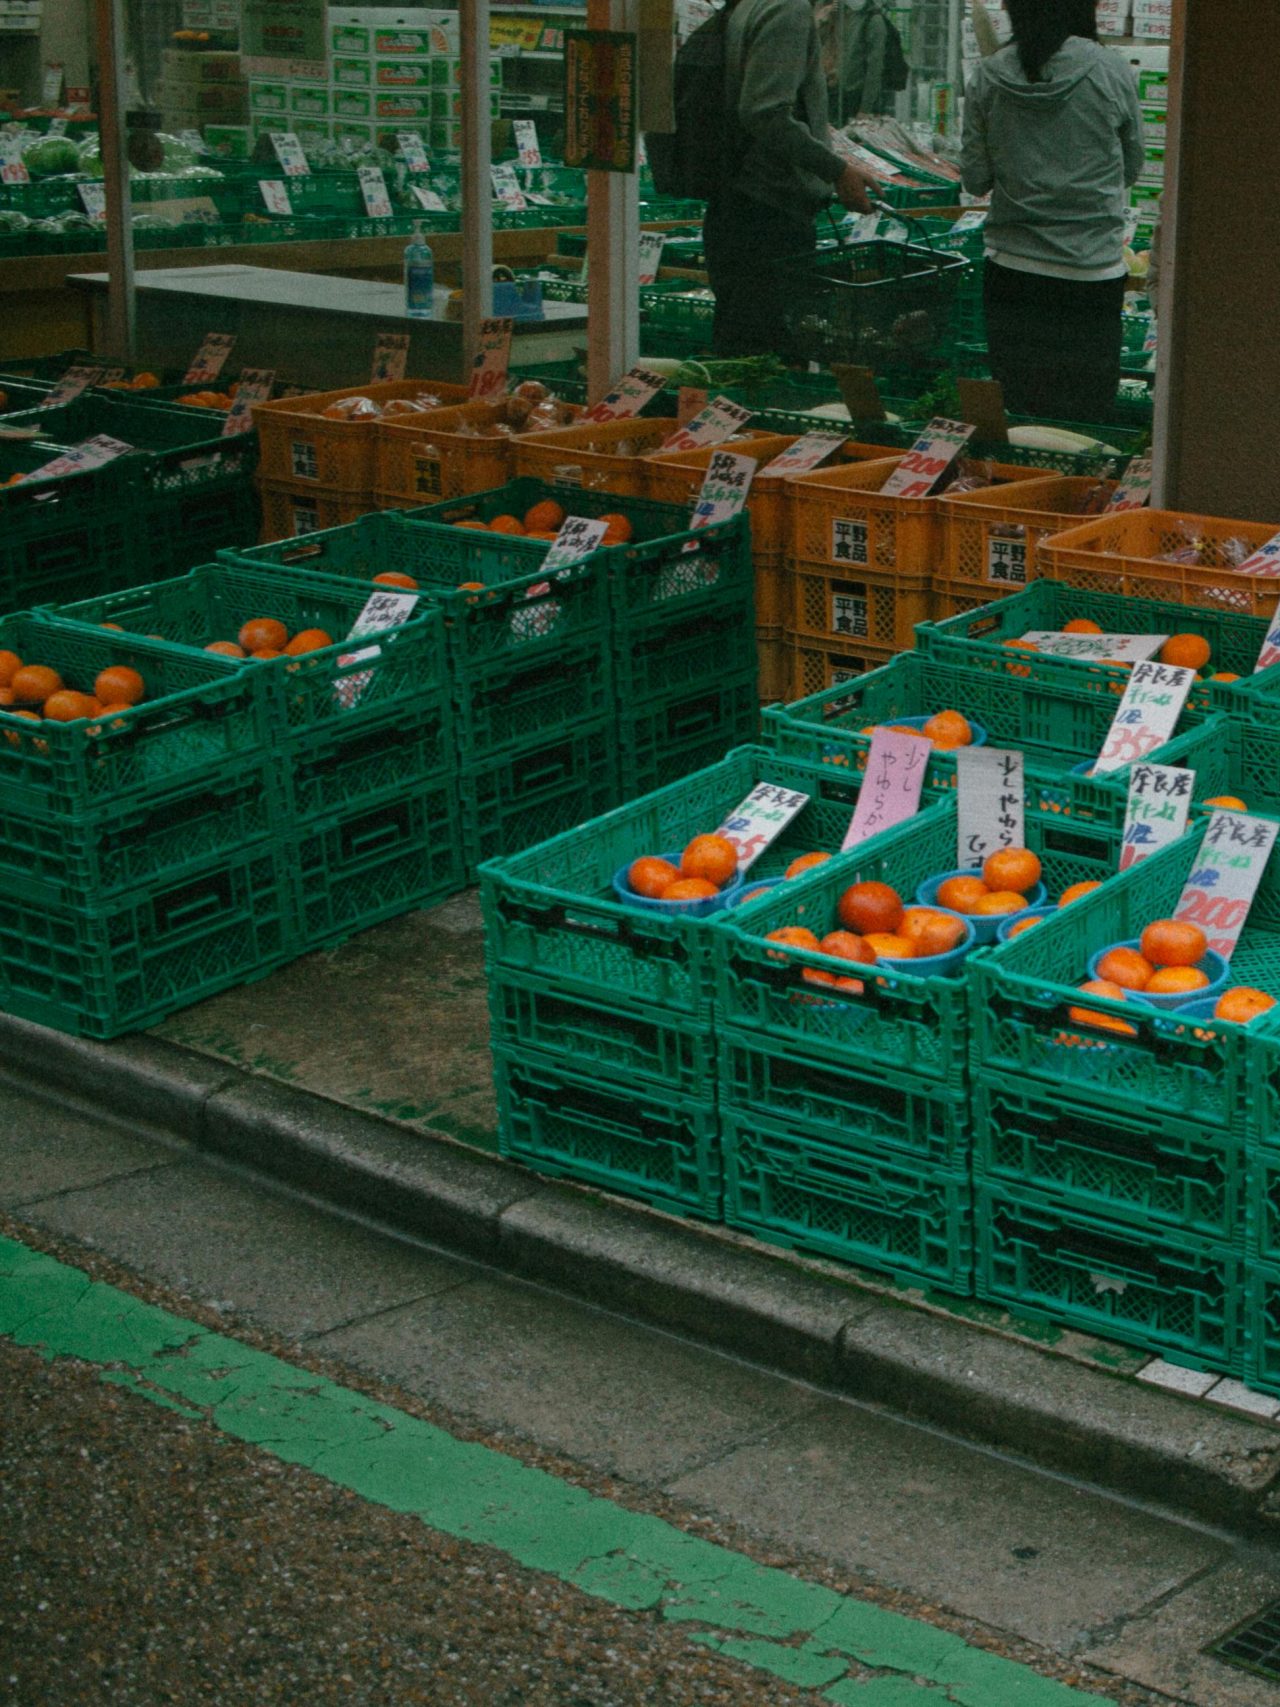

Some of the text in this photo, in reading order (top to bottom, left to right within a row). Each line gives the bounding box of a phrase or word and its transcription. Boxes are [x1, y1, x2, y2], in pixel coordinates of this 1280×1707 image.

[899, 452, 947, 476] 200
[1133, 663, 1187, 687] 奈良産
[903, 745, 926, 792] 少し
[1131, 766, 1192, 797] 奈良産
[1208, 814, 1272, 848] 奈良産
[1174, 889, 1251, 931] 200
